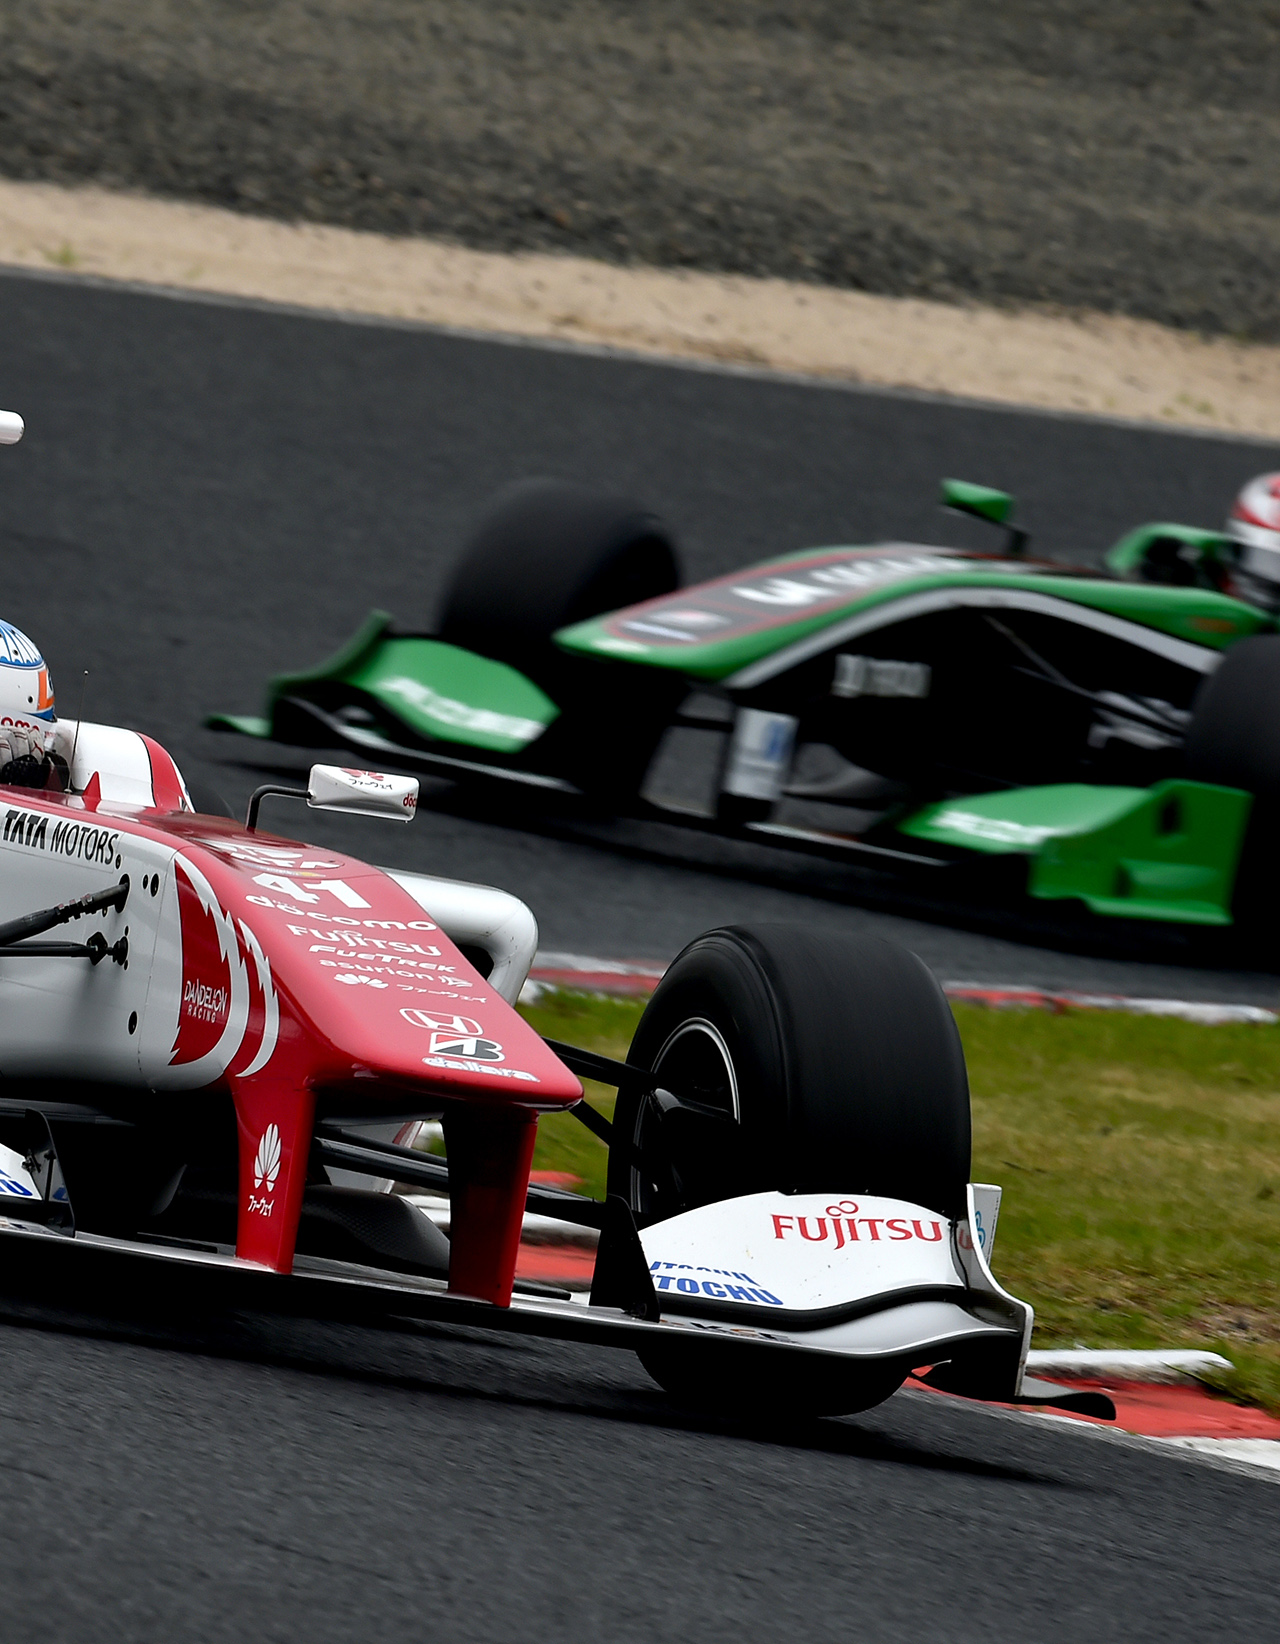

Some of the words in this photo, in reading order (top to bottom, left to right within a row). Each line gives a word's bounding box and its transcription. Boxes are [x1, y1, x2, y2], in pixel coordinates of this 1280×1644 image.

[3, 809, 49, 849] TATA
[50, 821, 119, 865] MOTORS
[252, 872, 372, 909] 41
[245, 894, 437, 931] docomo
[286, 923, 442, 957] FUJITSU
[319, 959, 435, 981] asurion
[187, 1004, 216, 1023] RACING
[771, 1212, 942, 1250] FUJITSU
[651, 1274, 784, 1306] TOCHU
